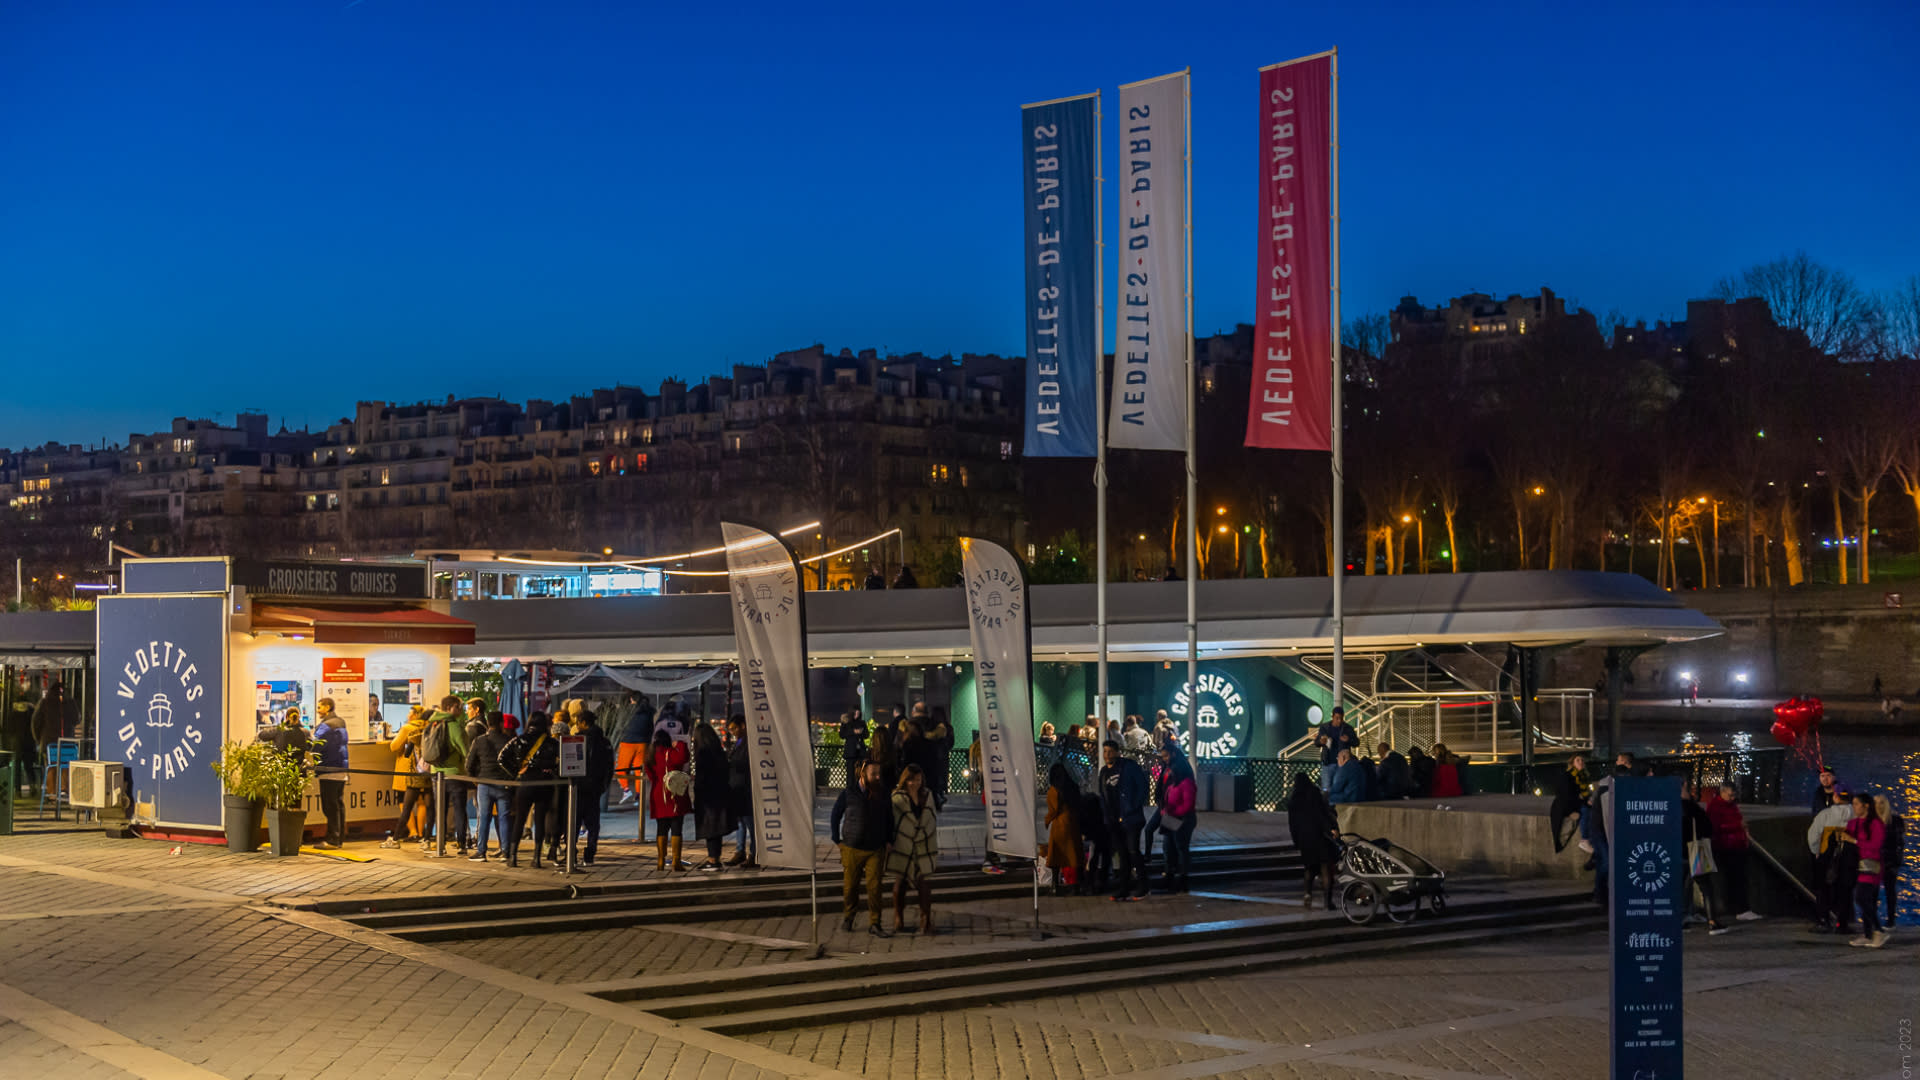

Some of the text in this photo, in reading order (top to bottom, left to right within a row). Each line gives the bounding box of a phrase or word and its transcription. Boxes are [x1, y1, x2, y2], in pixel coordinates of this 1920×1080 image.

[268, 567, 397, 593] CROISIÈRES CRUISES
[1171, 674, 1244, 716] CROSIERES
[117, 641, 204, 780] VEDETTES DE PARIS
[350, 791, 366, 808] DE
[1626, 800, 1669, 811] BIENVENUE
[1630, 815, 1665, 825] WELCOME
[1628, 841, 1671, 864] VEDETTES
[1628, 871, 1641, 886] DE
[1645, 871, 1671, 892] PARIS
[1629, 936, 1670, 948] VEDETTES
